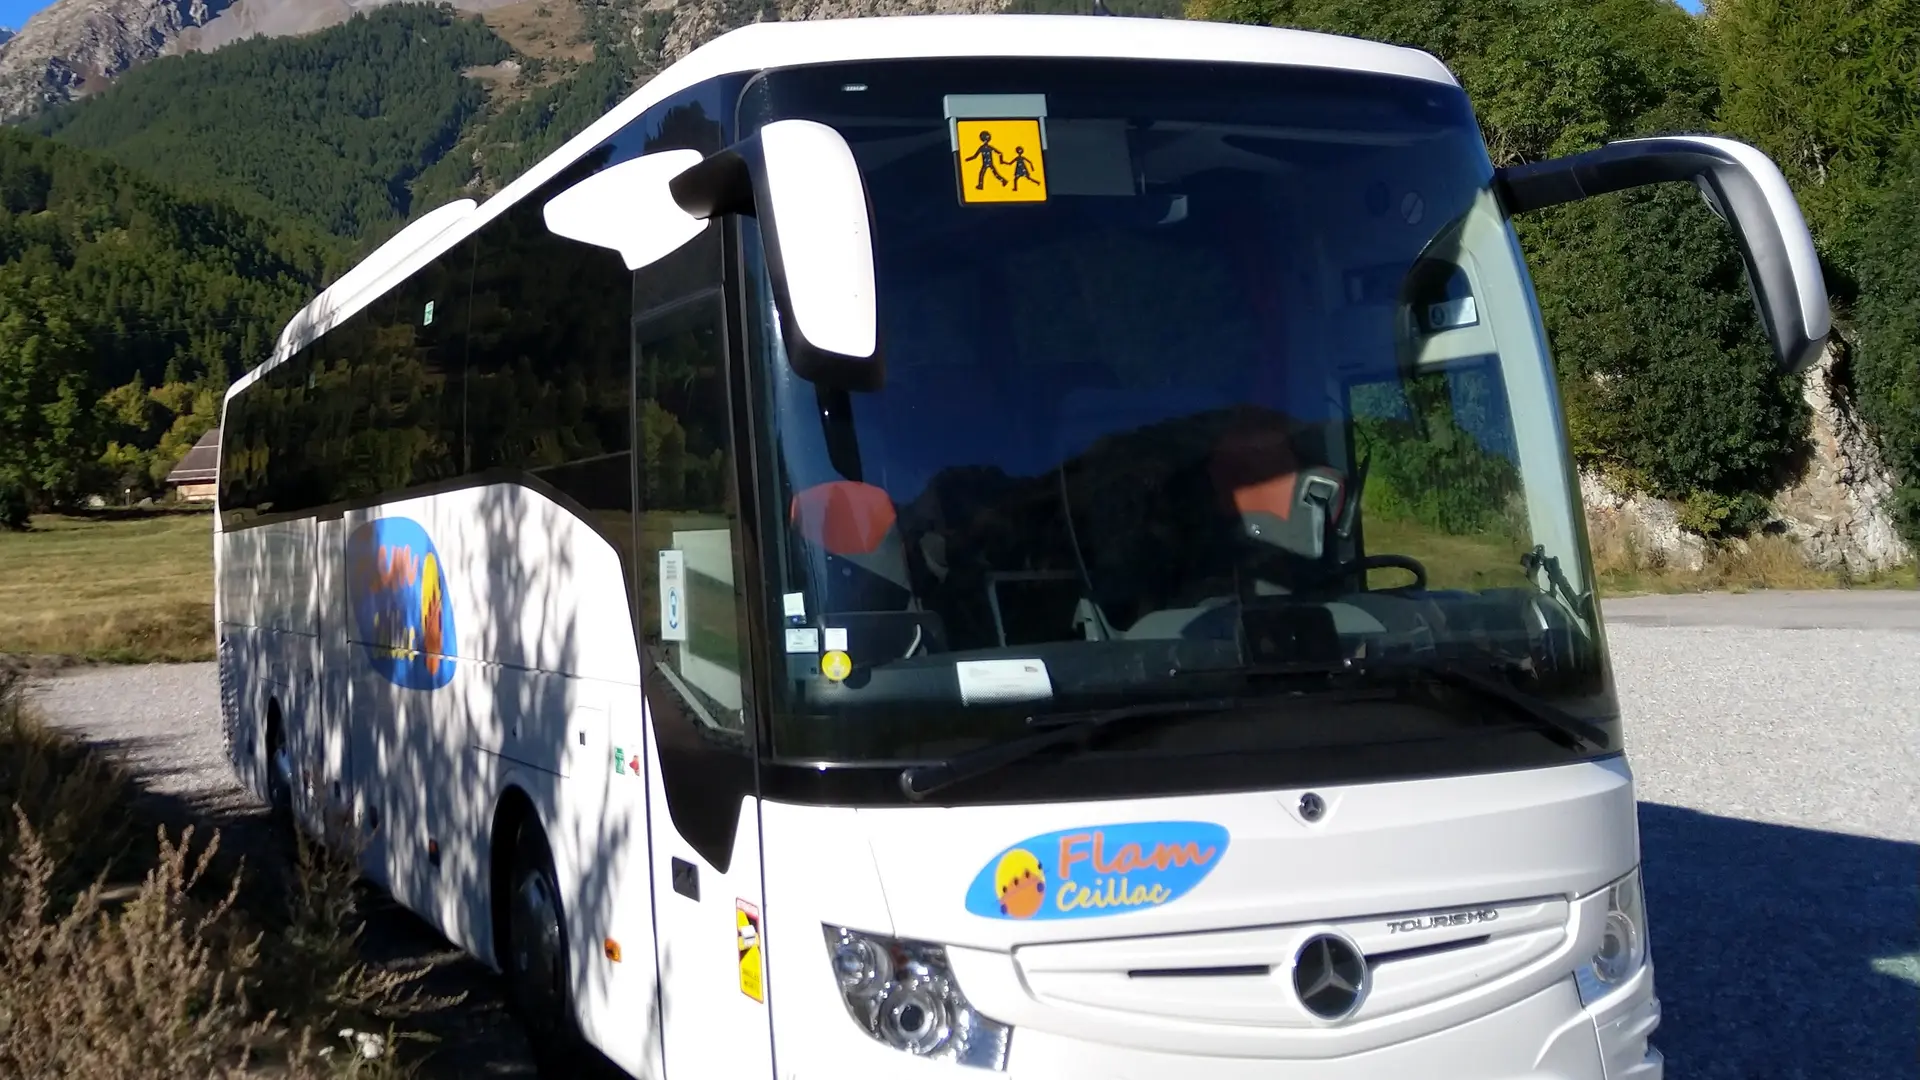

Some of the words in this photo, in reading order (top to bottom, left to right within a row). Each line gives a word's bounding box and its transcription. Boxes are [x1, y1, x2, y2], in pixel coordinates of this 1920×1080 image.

[1057, 831, 1217, 880] Flam
[1056, 878, 1172, 912] Ceillac
[1386, 908, 1500, 935] TOURISMO
